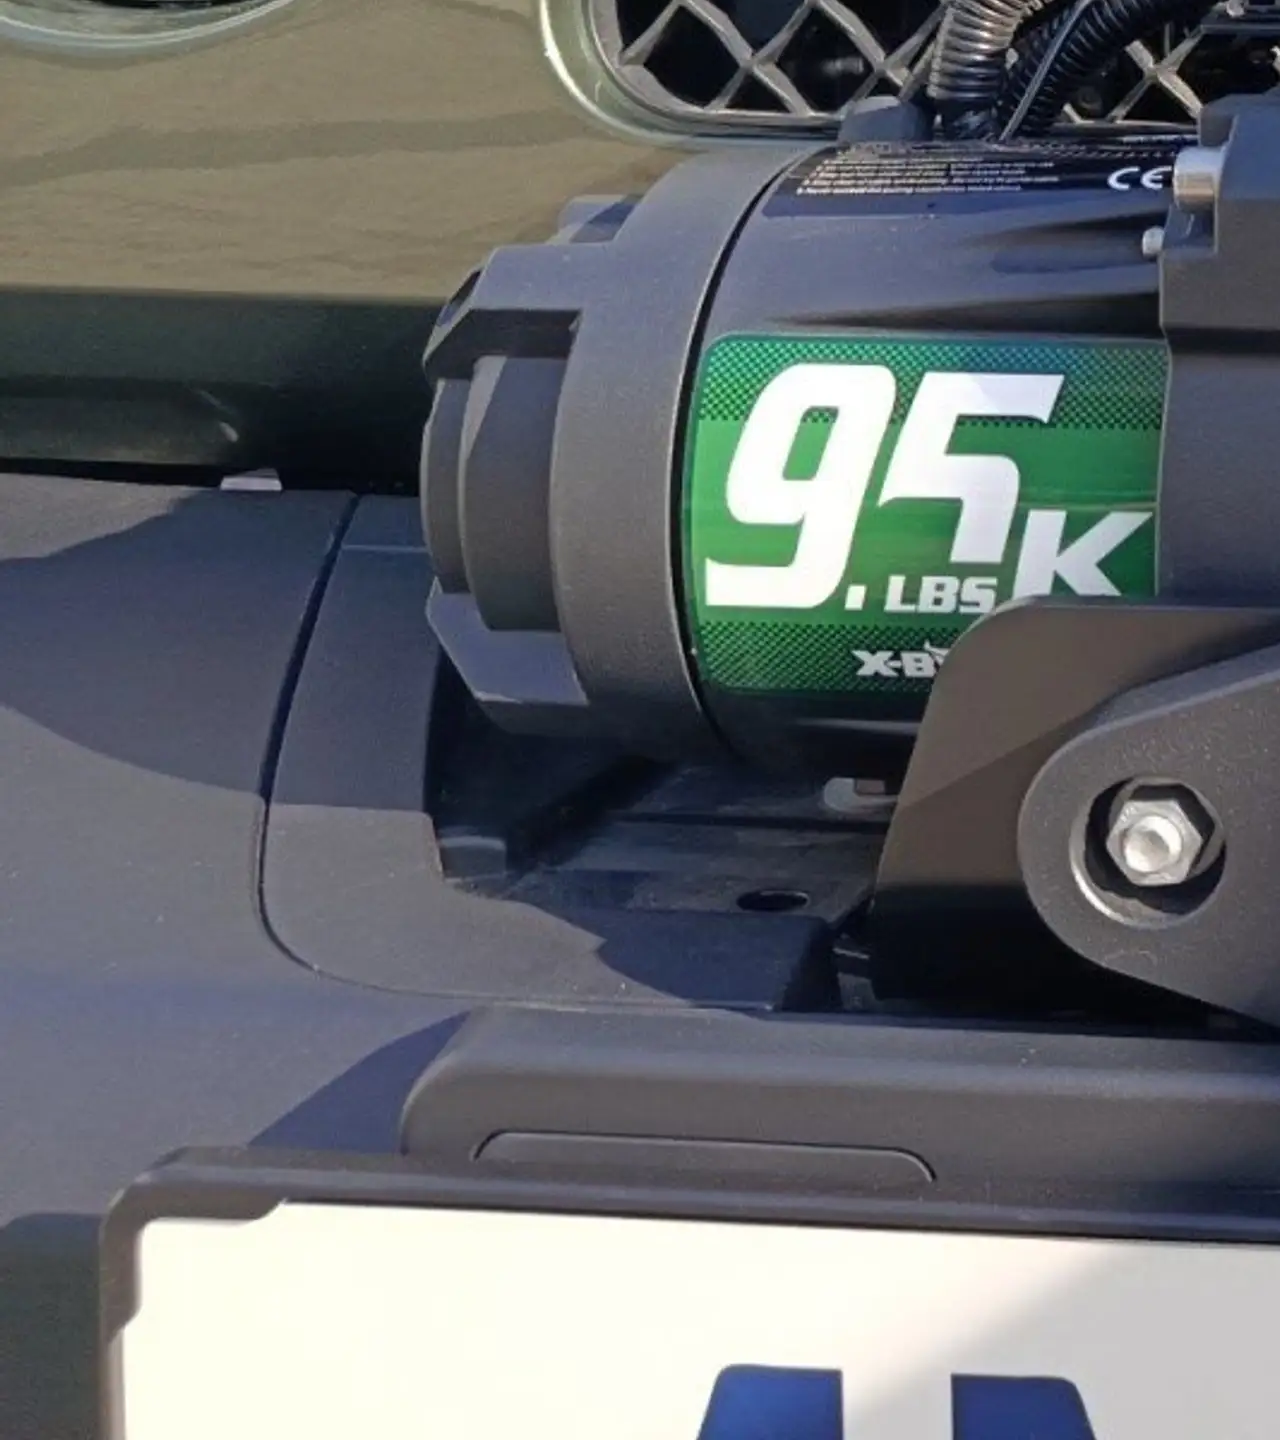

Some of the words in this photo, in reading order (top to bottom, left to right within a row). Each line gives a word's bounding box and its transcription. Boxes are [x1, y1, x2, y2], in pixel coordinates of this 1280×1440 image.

[1107, 166, 1173, 191] CE
[884, 575, 998, 614] LBS
[851, 640, 950, 677] X-B
